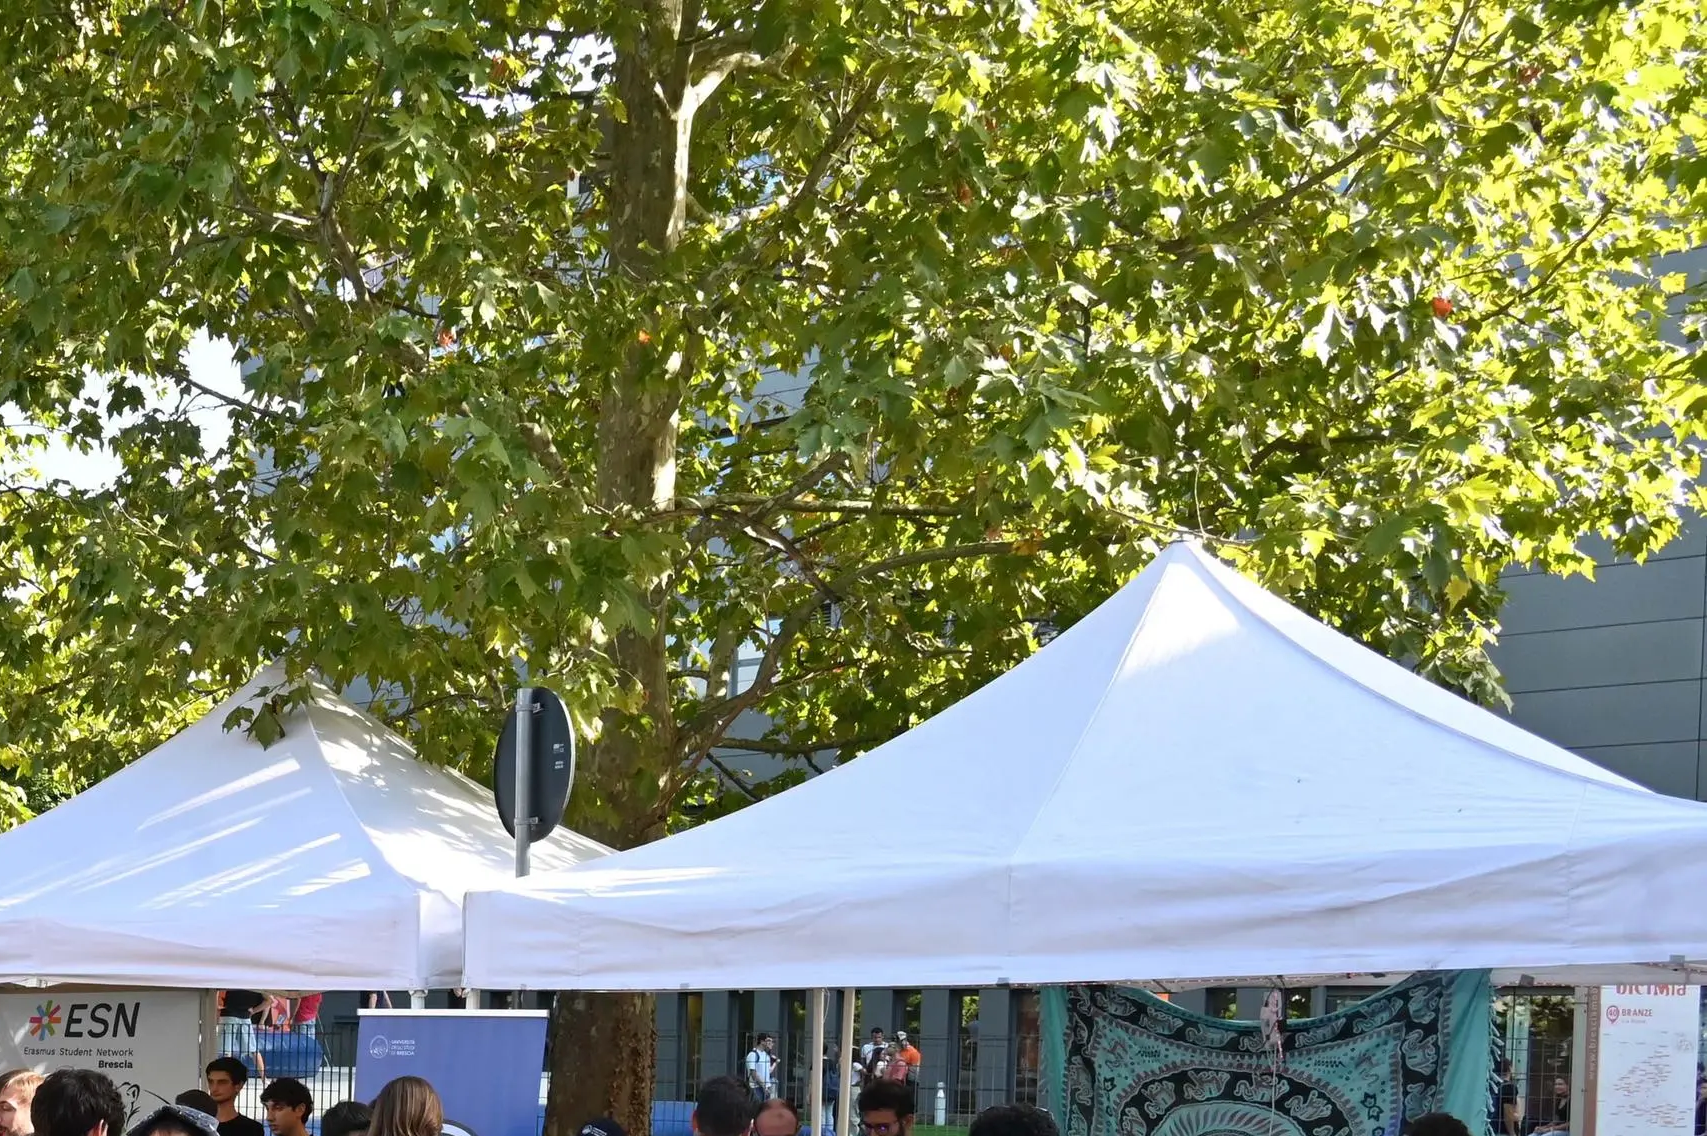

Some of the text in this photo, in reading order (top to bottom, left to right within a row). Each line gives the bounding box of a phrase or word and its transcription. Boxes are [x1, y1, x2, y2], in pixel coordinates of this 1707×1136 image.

[1621, 1008, 1653, 1017] BRANZE
[64, 1002, 140, 1038] ESN
[23, 1047, 134, 1057] Erasmus Student Network
[98, 1060, 133, 1069] Brescia
